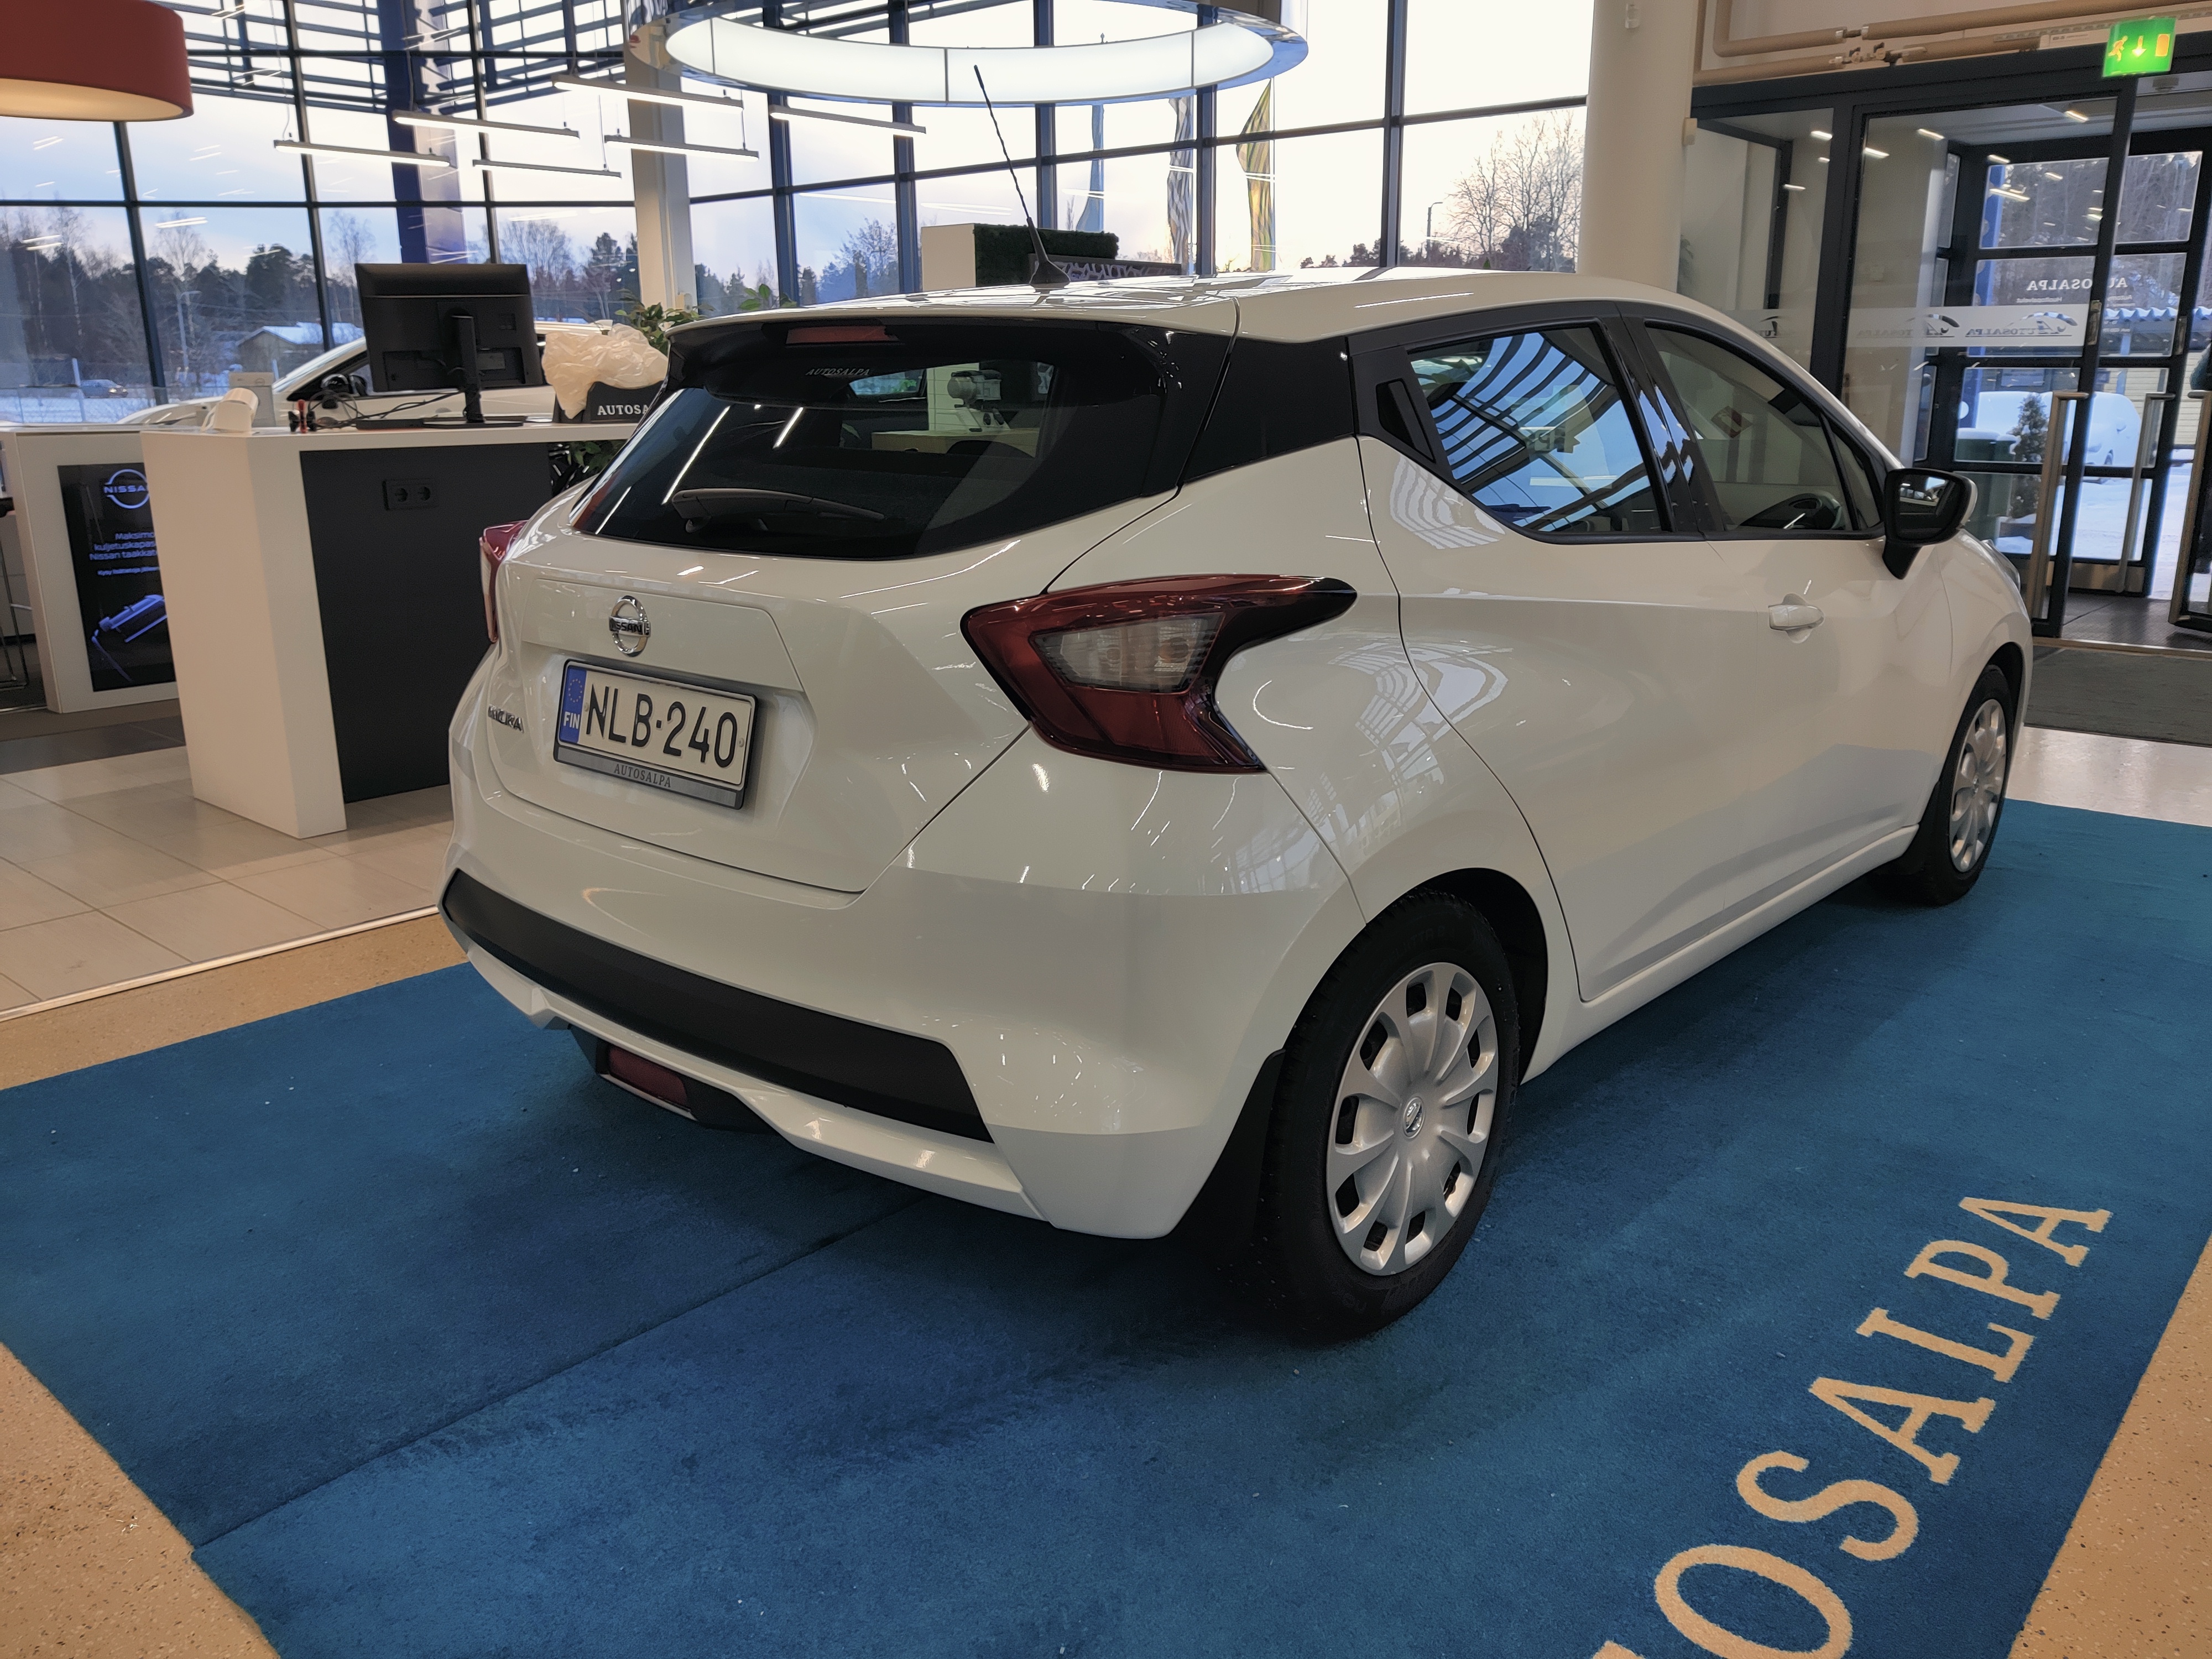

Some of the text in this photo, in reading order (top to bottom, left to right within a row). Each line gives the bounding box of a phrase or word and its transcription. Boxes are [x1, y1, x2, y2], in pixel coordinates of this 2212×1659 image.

[609, 618, 643, 634] NISSAN
[563, 711, 580, 729] FIN
[614, 763, 671, 788] AUTOSALPA
[1593, 1196, 2113, 1659] OSALPA
